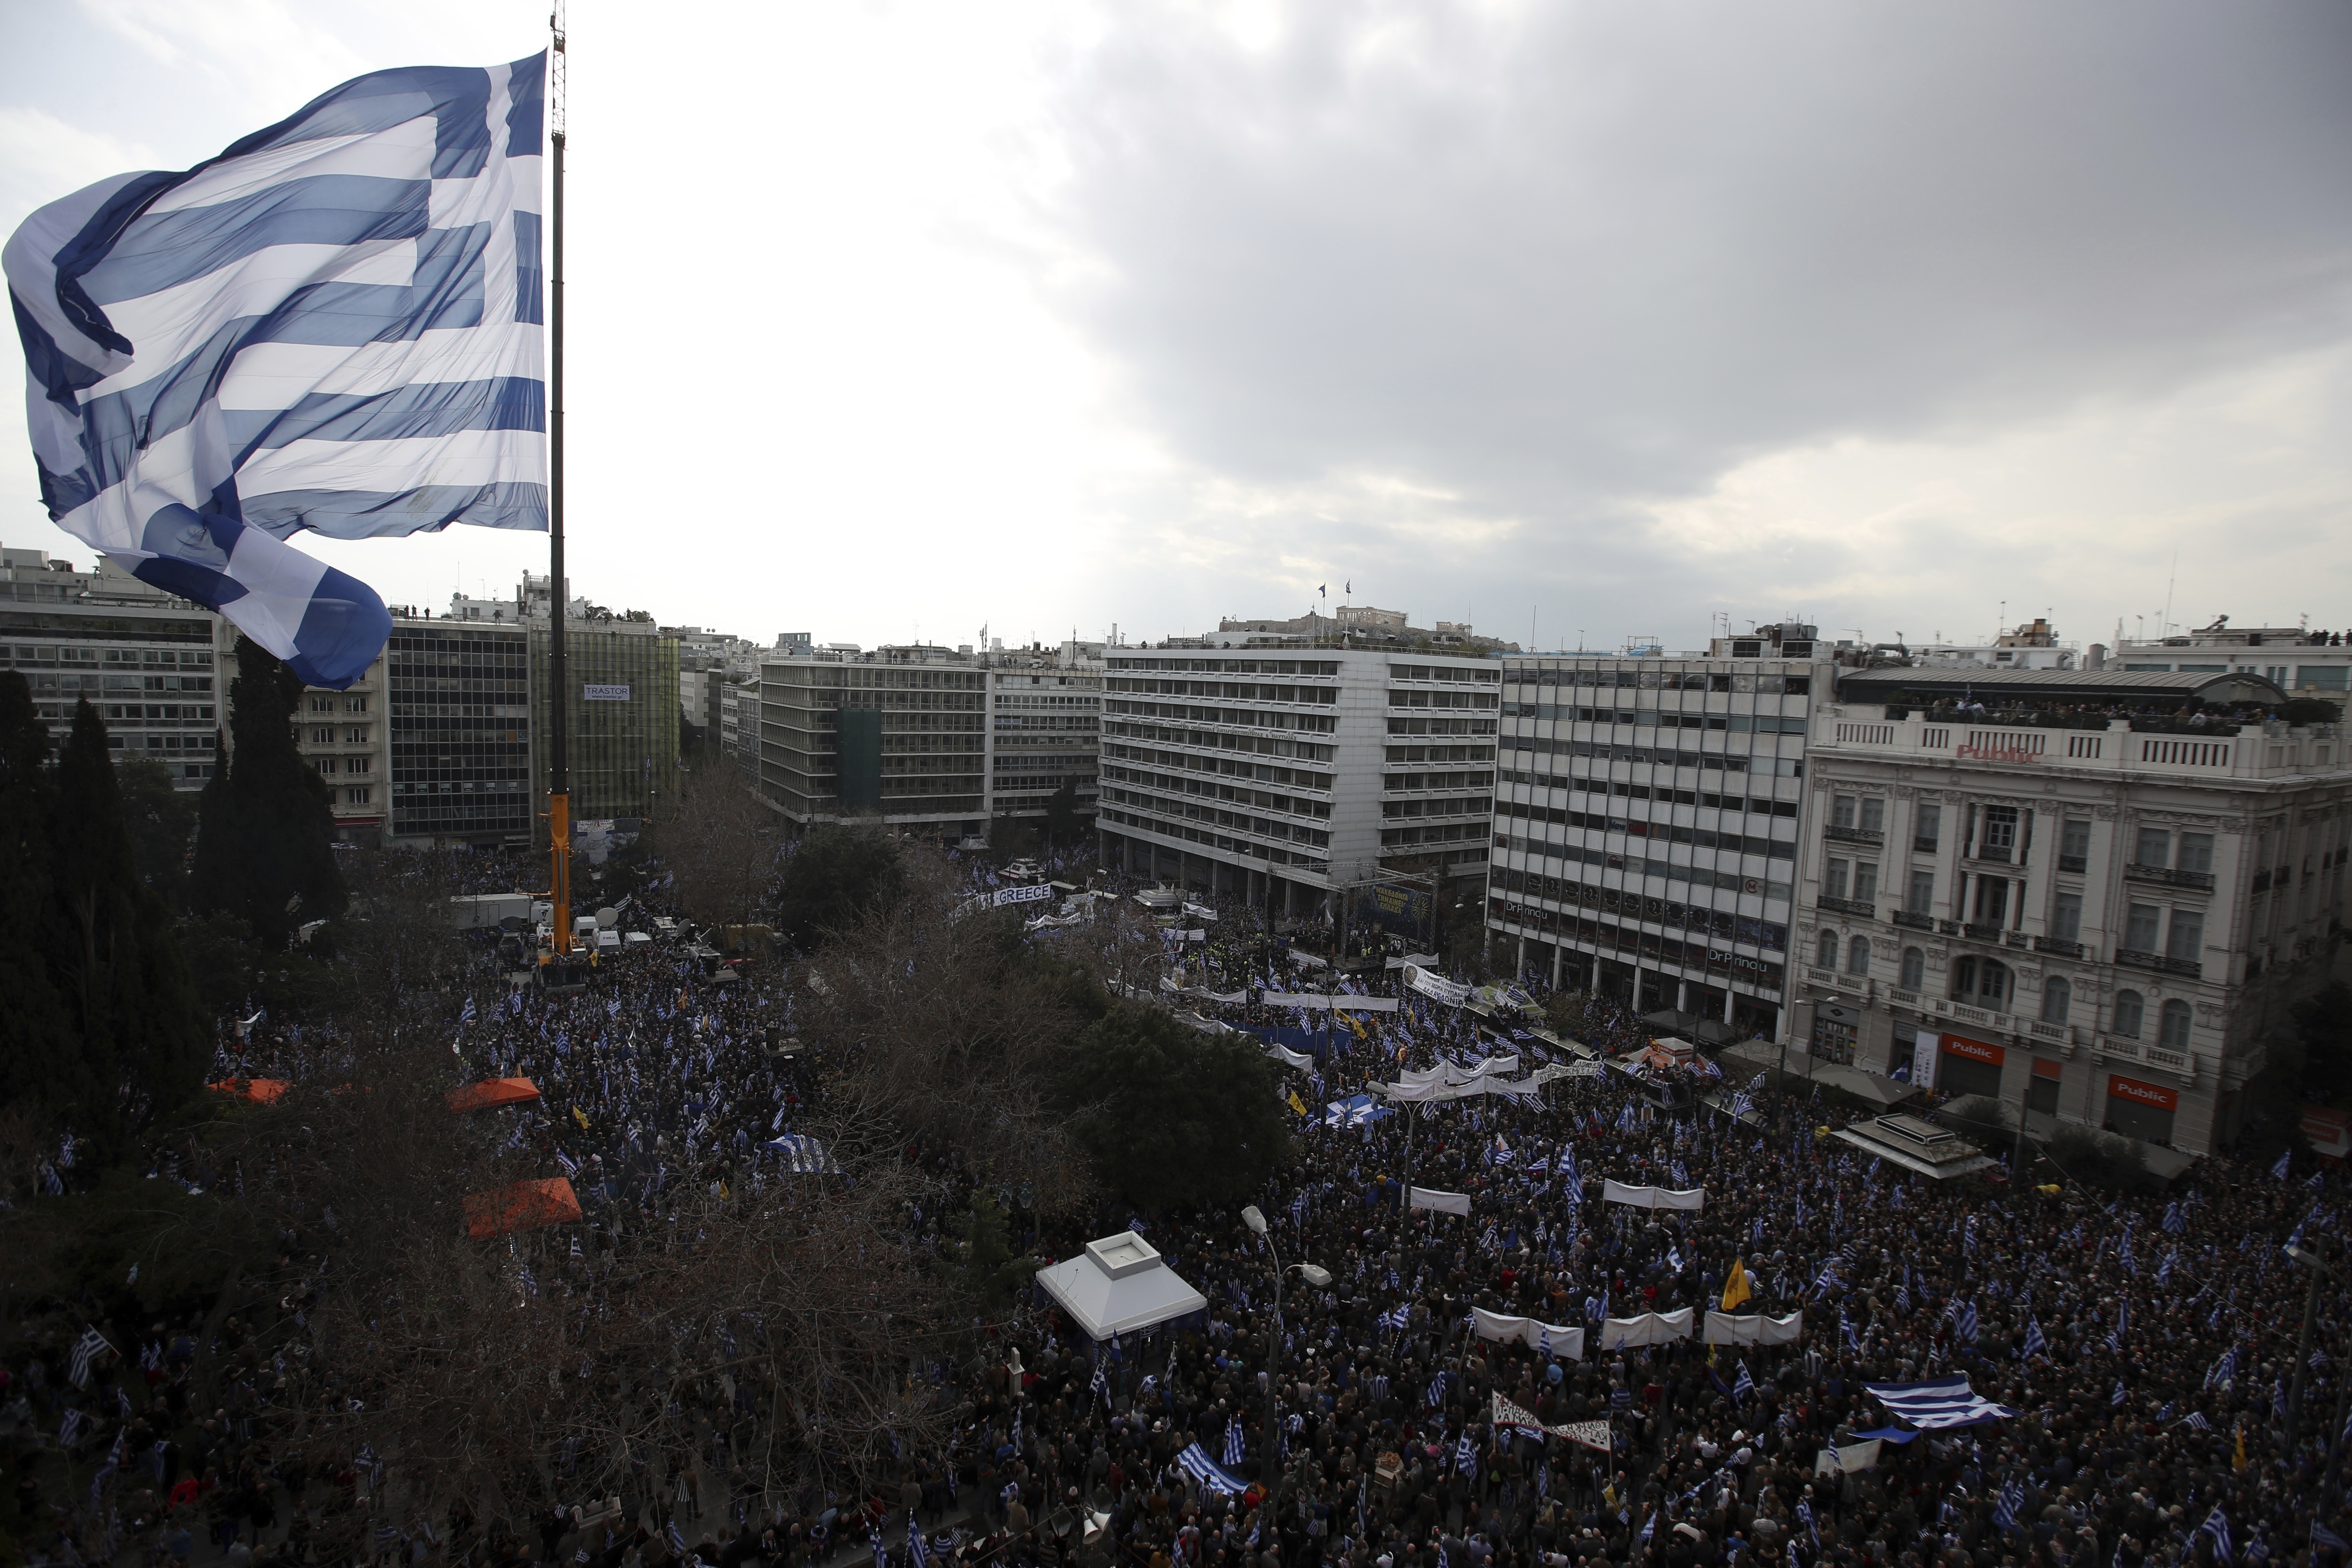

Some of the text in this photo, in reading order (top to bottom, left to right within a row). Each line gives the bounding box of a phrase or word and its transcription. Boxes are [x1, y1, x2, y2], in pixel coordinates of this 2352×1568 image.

[1957, 744, 2040, 764] Public
[1609, 820, 1626, 830] New
[999, 885, 1048, 903] GREECE
[1506, 902, 1516, 912] Dr
[1709, 949, 1724, 962] Dr
[1550, 957, 1580, 969] Monald's
[1625, 977, 1659, 990] Mcnald's
[1952, 1041, 1993, 1059] Public
[2117, 1083, 2167, 1104] Public
